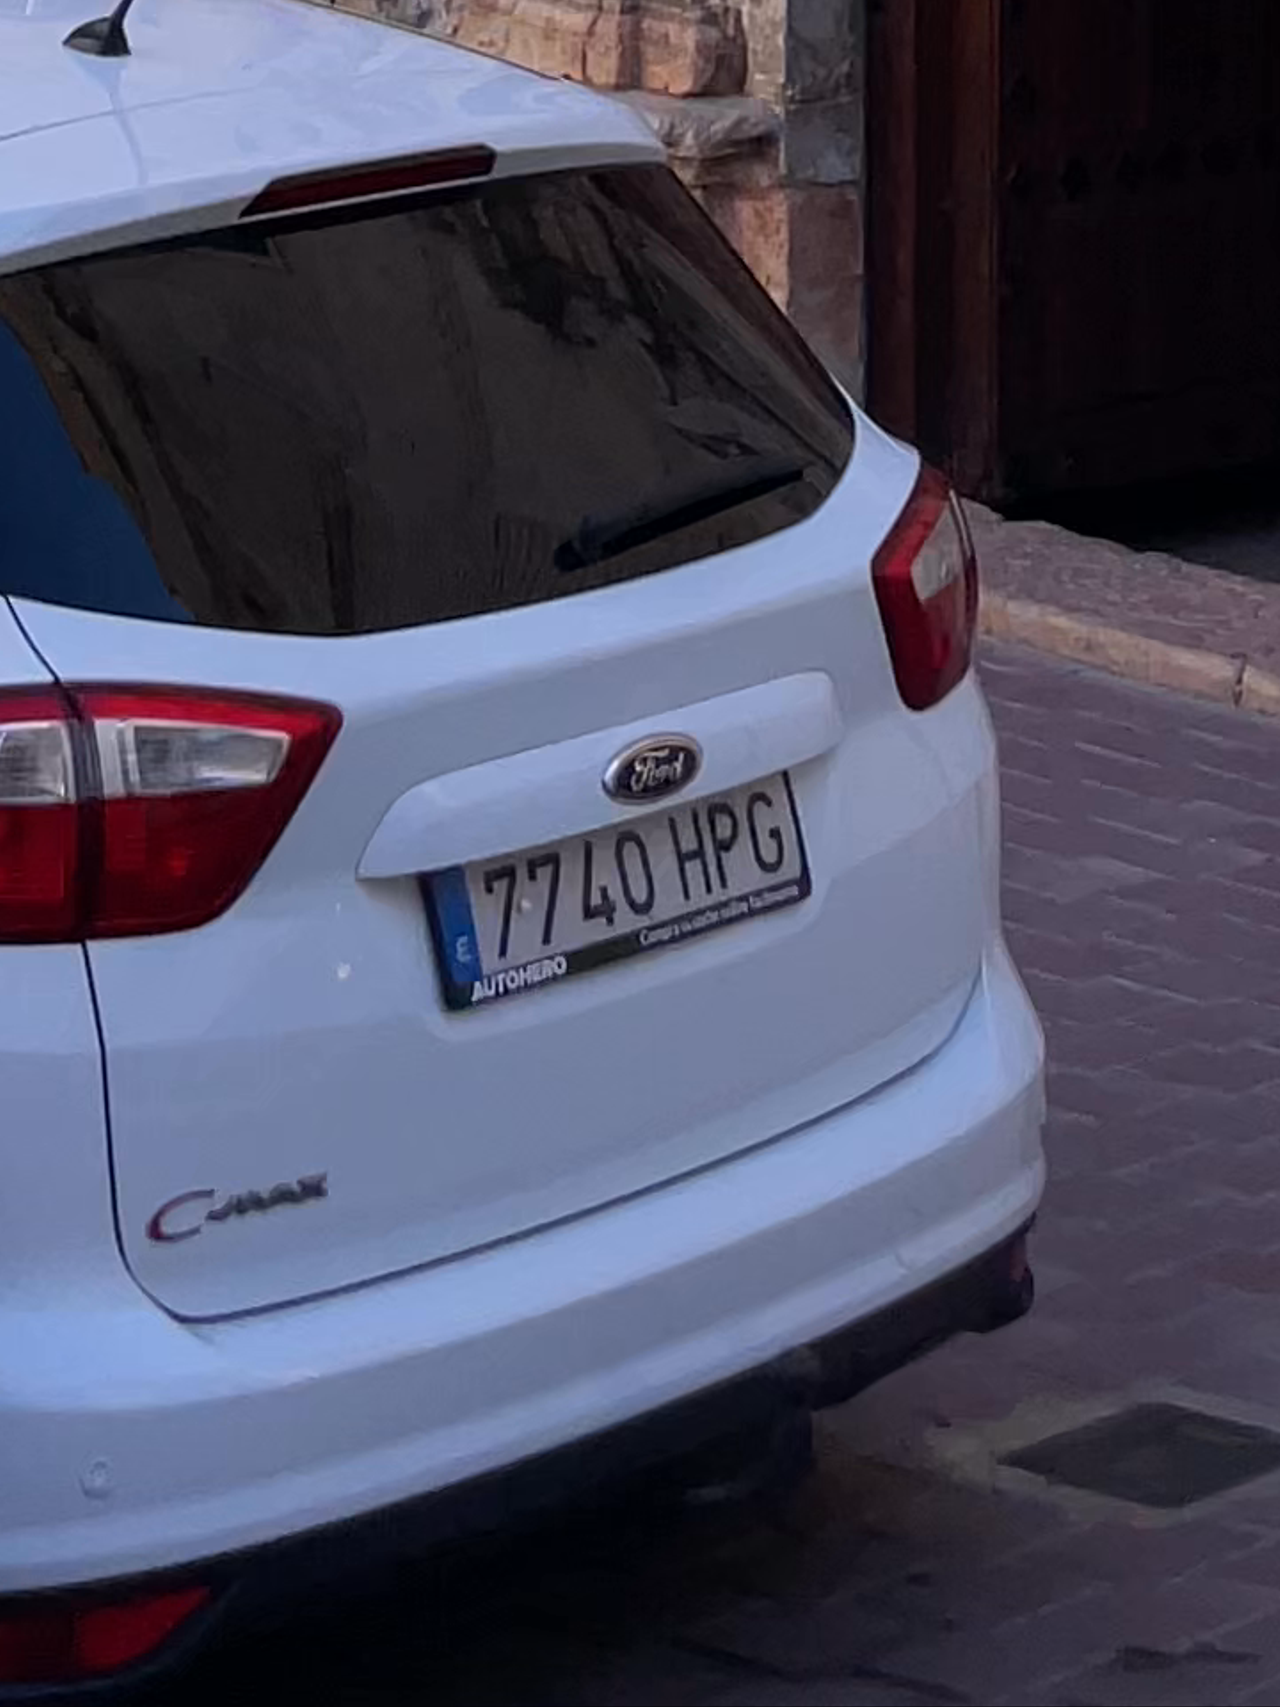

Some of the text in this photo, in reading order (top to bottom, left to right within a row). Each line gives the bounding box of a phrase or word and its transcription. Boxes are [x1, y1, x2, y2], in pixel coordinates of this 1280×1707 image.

[630, 748, 685, 792] Ford
[482, 790, 785, 960] 7740 HPG
[455, 934, 471, 964] E
[470, 954, 568, 1002] AUTOHERO
